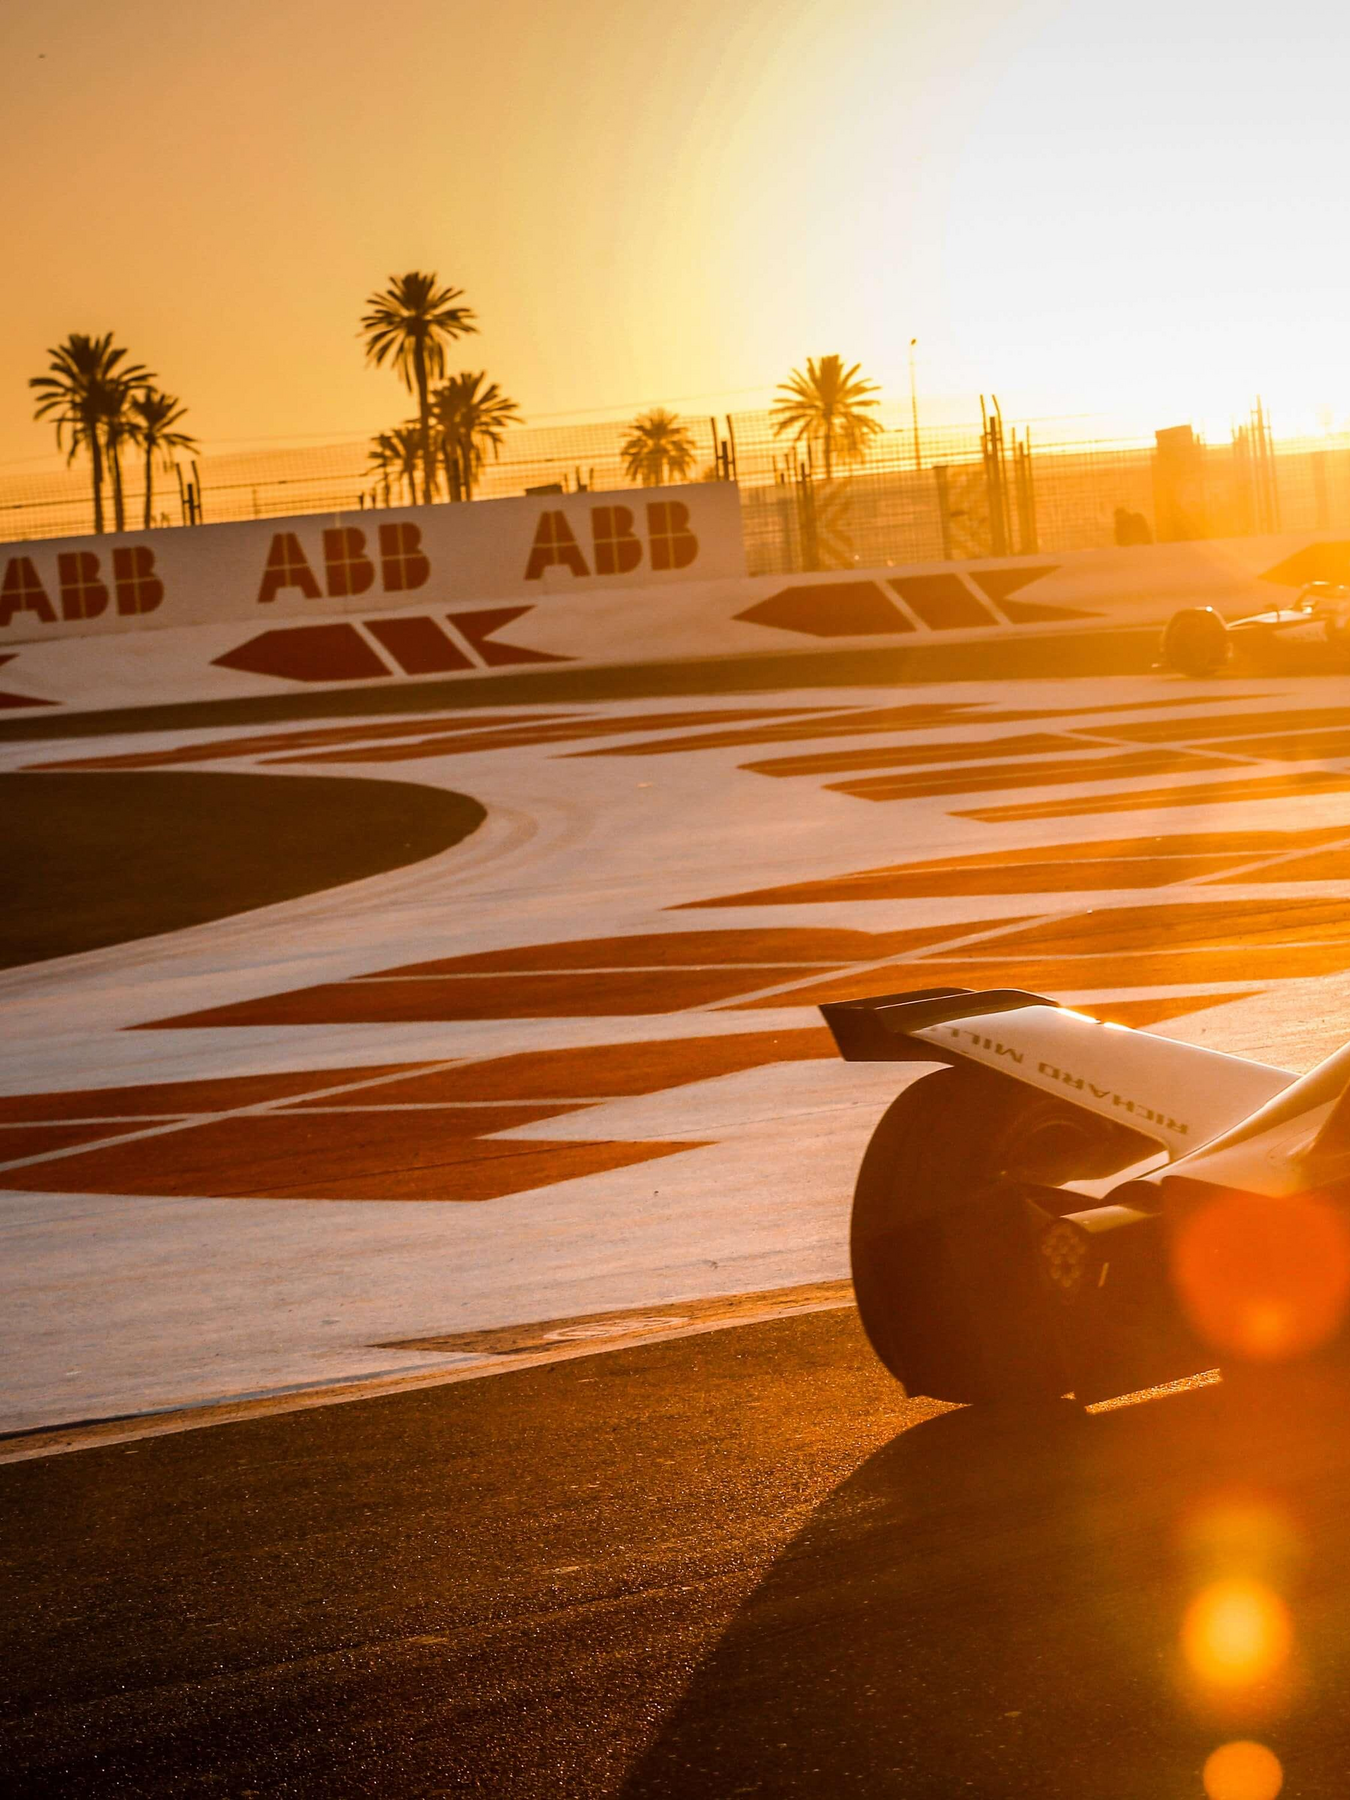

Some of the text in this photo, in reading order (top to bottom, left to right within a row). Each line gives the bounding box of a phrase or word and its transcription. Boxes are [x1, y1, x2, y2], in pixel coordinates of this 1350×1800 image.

[257, 521, 431, 603] ABB
[524, 500, 700, 581] ABB
[0, 545, 165, 627] ABB
[929, 1026, 1189, 1136] RICHARD MILL
